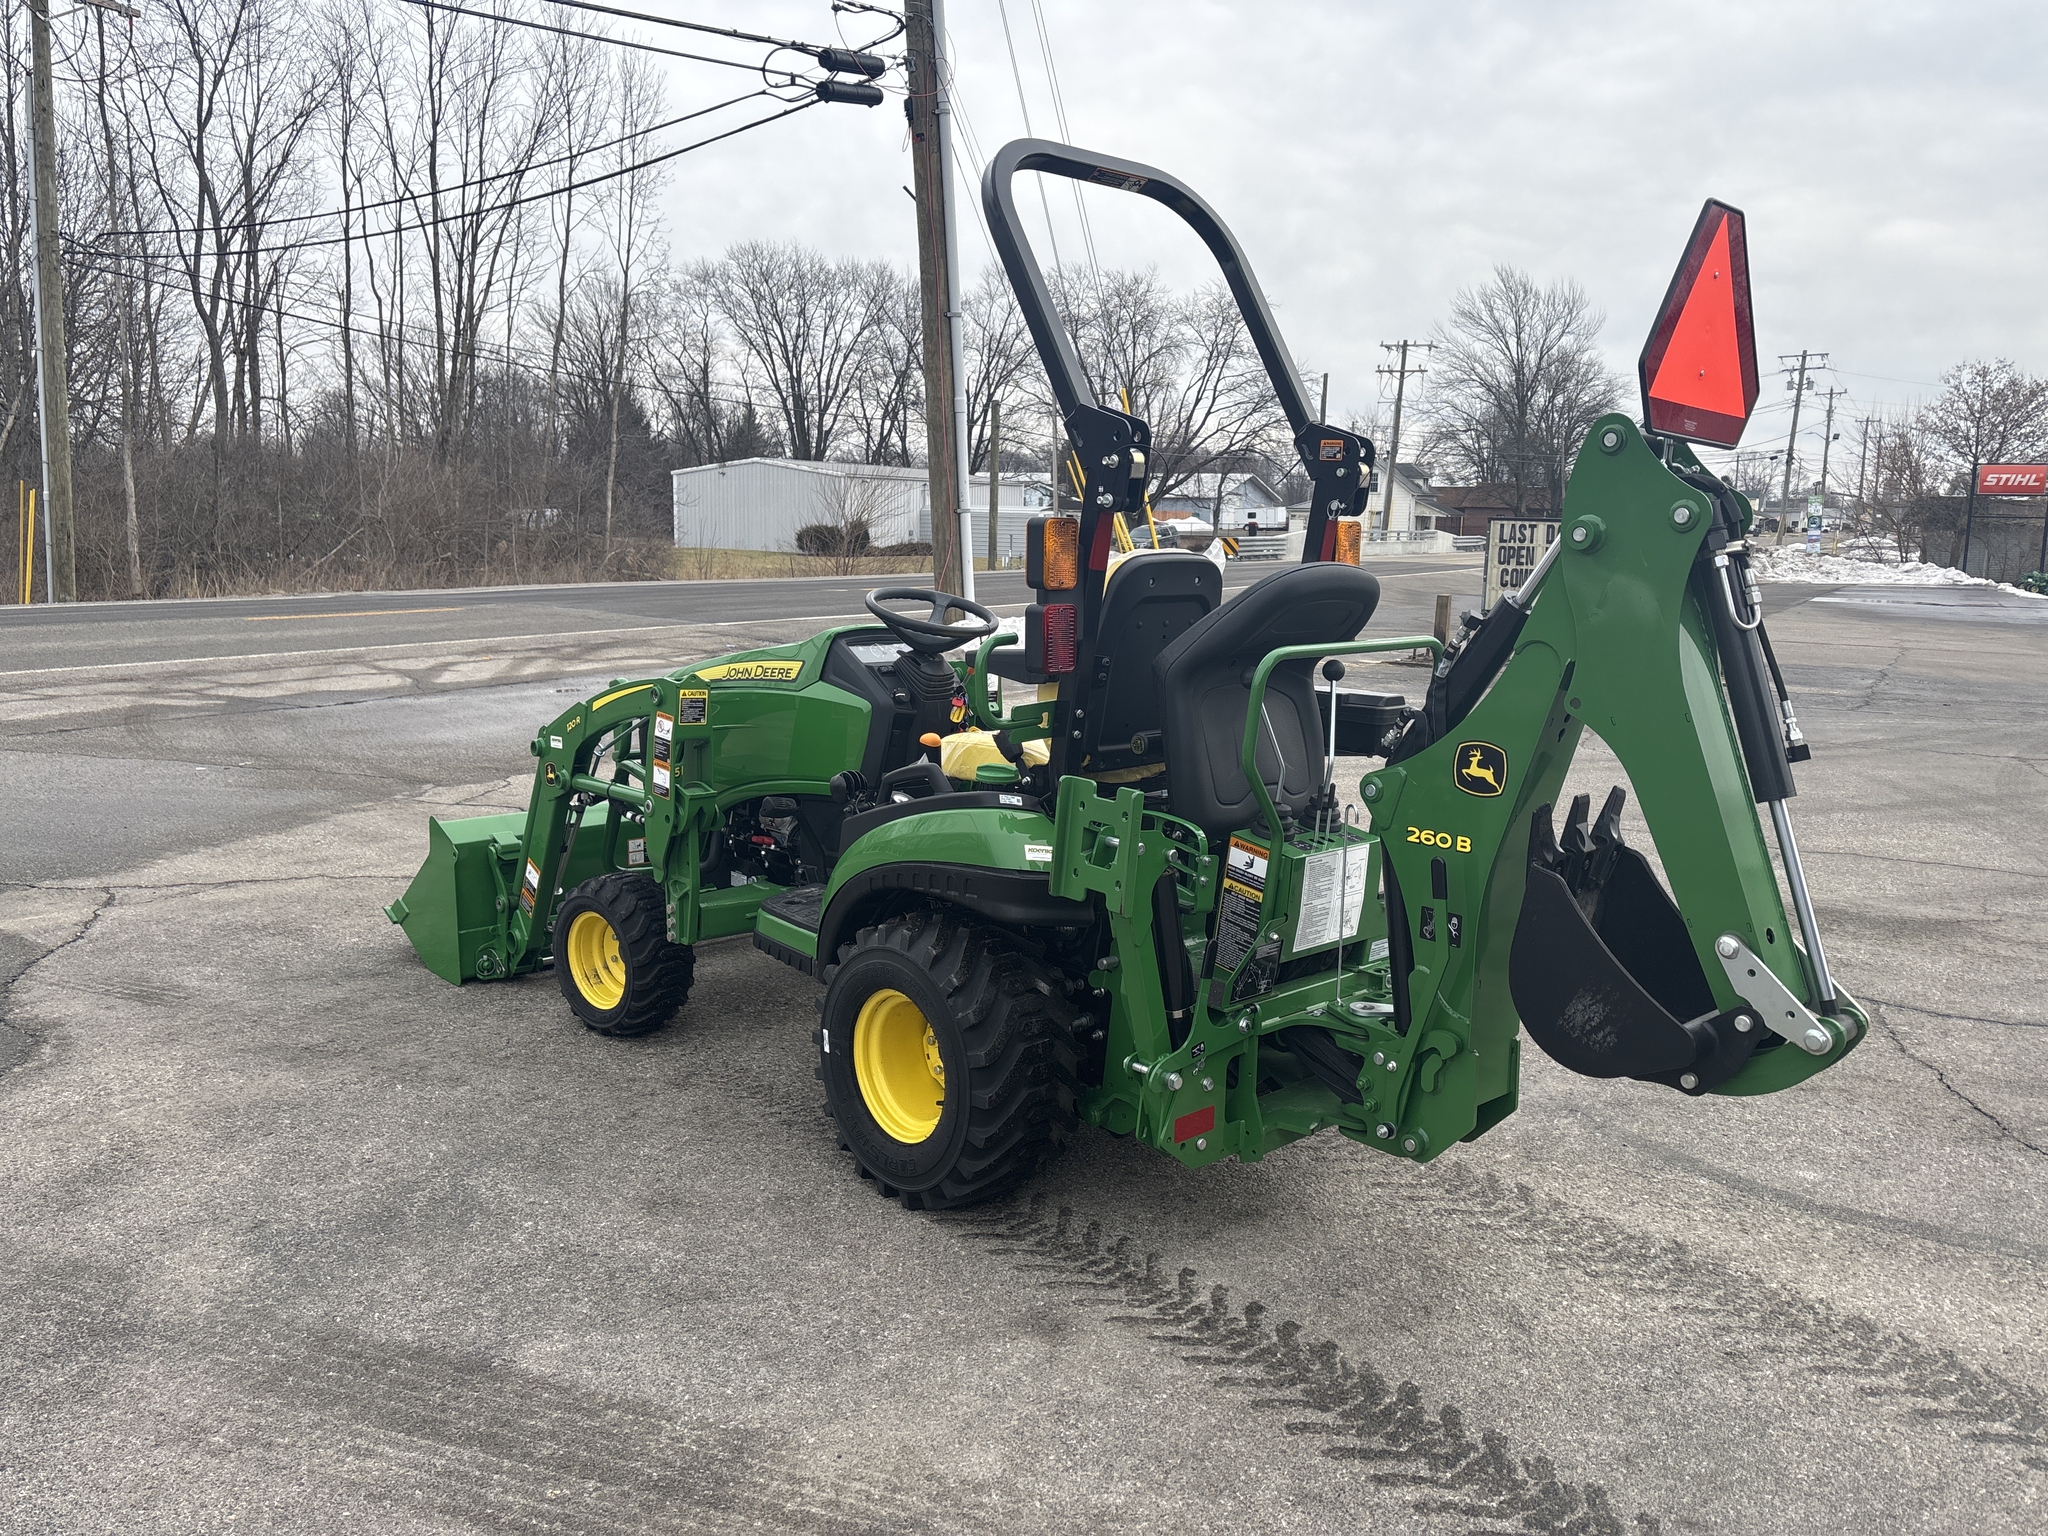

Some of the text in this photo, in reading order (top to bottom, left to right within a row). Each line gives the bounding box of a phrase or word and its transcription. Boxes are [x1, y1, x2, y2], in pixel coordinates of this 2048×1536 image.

[1983, 473, 2041, 486] STIHL
[1499, 523, 1561, 544] LAST D
[1497, 545, 1535, 566] OPEN
[722, 665, 794, 680] JOHN DEERE
[1406, 826, 1472, 853] 260 B
[1240, 844, 1268, 859] WARNING
[1233, 885, 1261, 901] CAUTION
